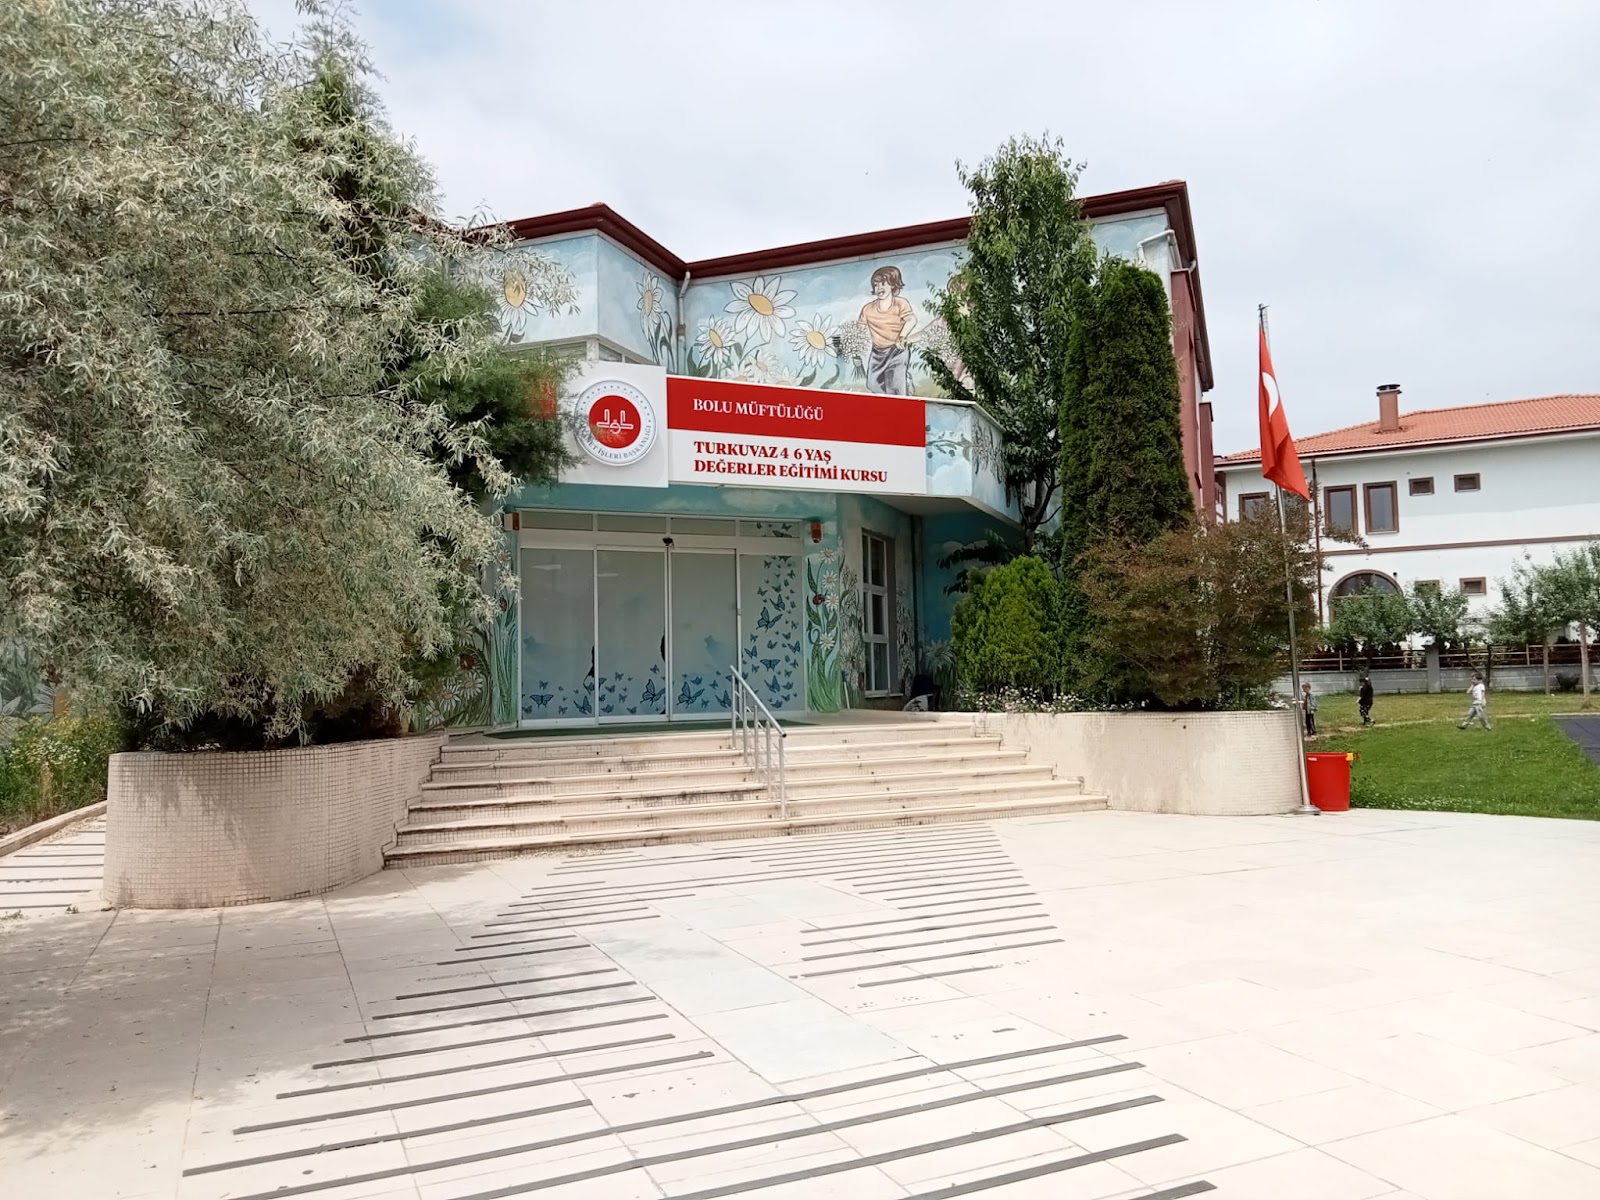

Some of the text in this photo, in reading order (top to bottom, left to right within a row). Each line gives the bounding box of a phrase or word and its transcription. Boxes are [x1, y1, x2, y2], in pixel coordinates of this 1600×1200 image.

[693, 398, 824, 421] BOLU MÜFTÜLÜĞÜ
[694, 441, 832, 465] TURKUVAZ 4 6 YAŞ
[694, 459, 888, 483] DEĞERLER EĞİTİMİ KURSU
